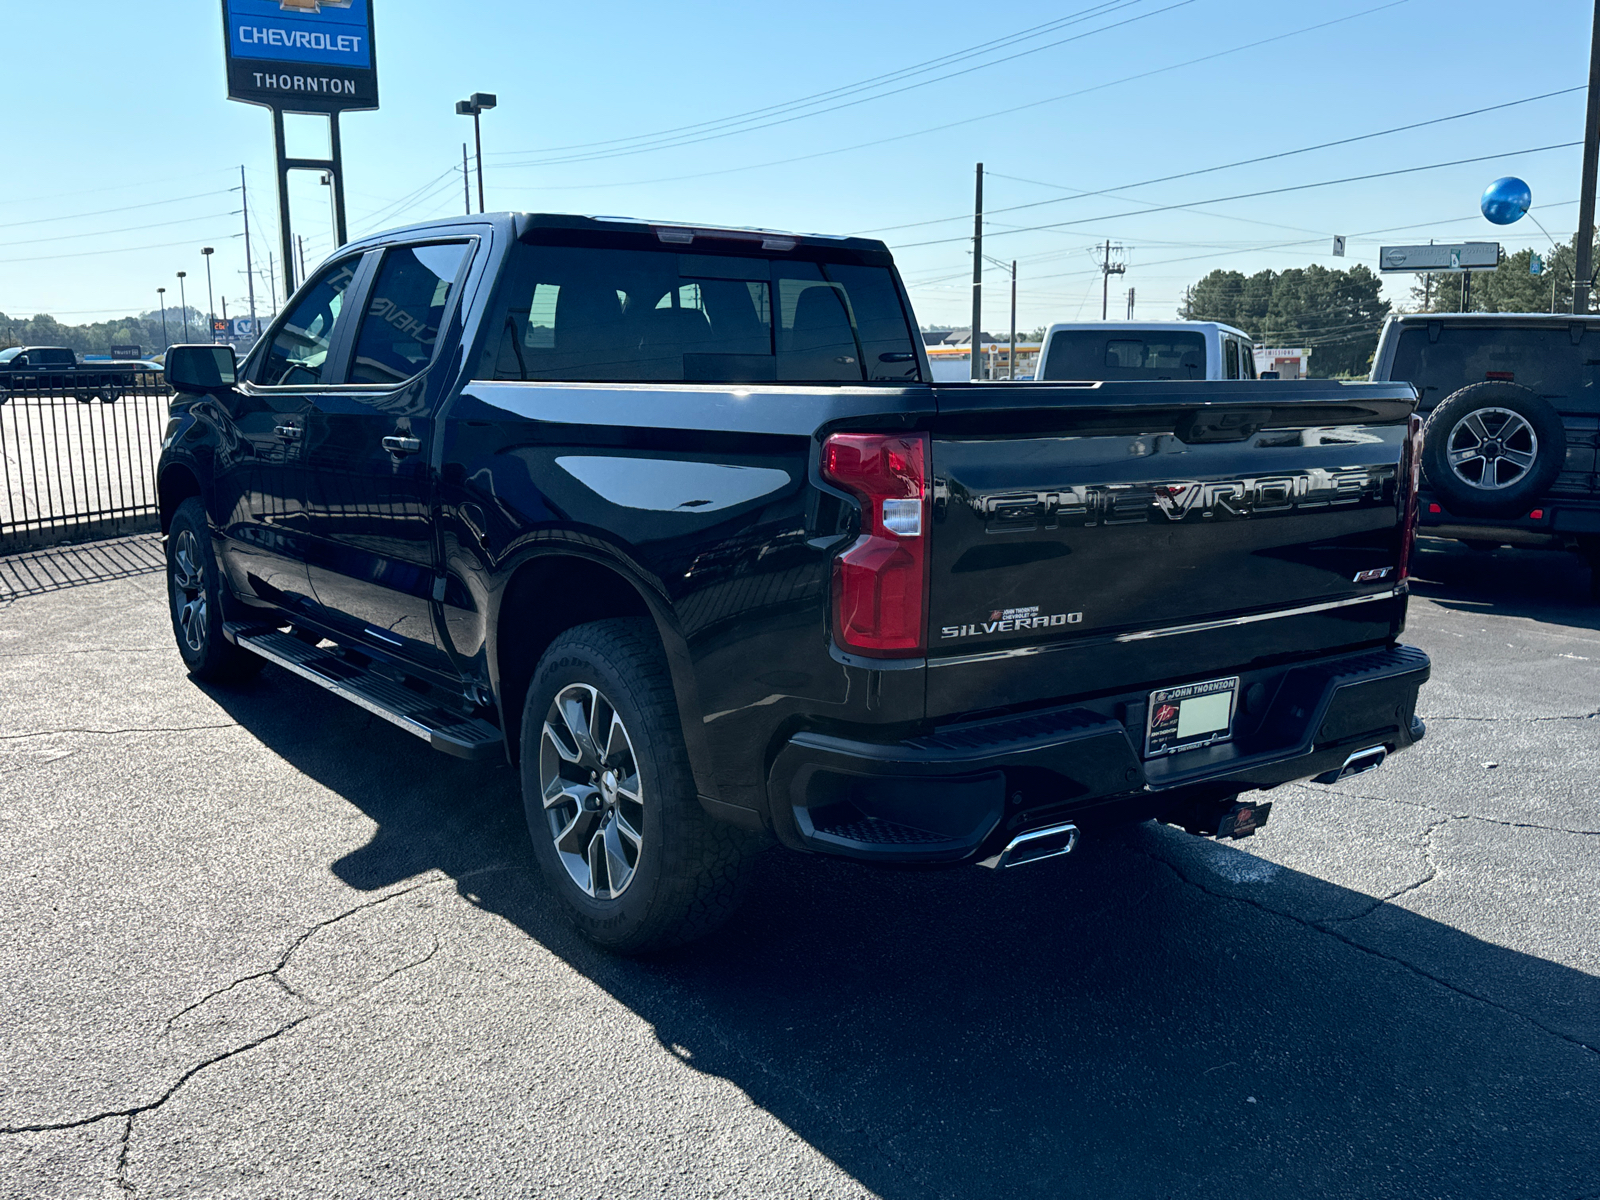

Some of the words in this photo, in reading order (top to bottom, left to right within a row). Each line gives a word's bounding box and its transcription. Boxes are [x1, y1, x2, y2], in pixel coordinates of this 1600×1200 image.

[239, 25, 361, 52] CHEVROLET
[253, 72, 356, 95] THORNTON
[985, 469, 1396, 534] CHEVROLET
[1353, 566, 1394, 583] RST
[1002, 608, 1015, 616] JOHN
[1015, 606, 1039, 614] THORNTON
[941, 612, 1083, 639] SILVERADO
[1171, 687, 1193, 699] JOHN
[1194, 680, 1235, 695] THORNTON
[1177, 743, 1203, 753] CHEVROLET
